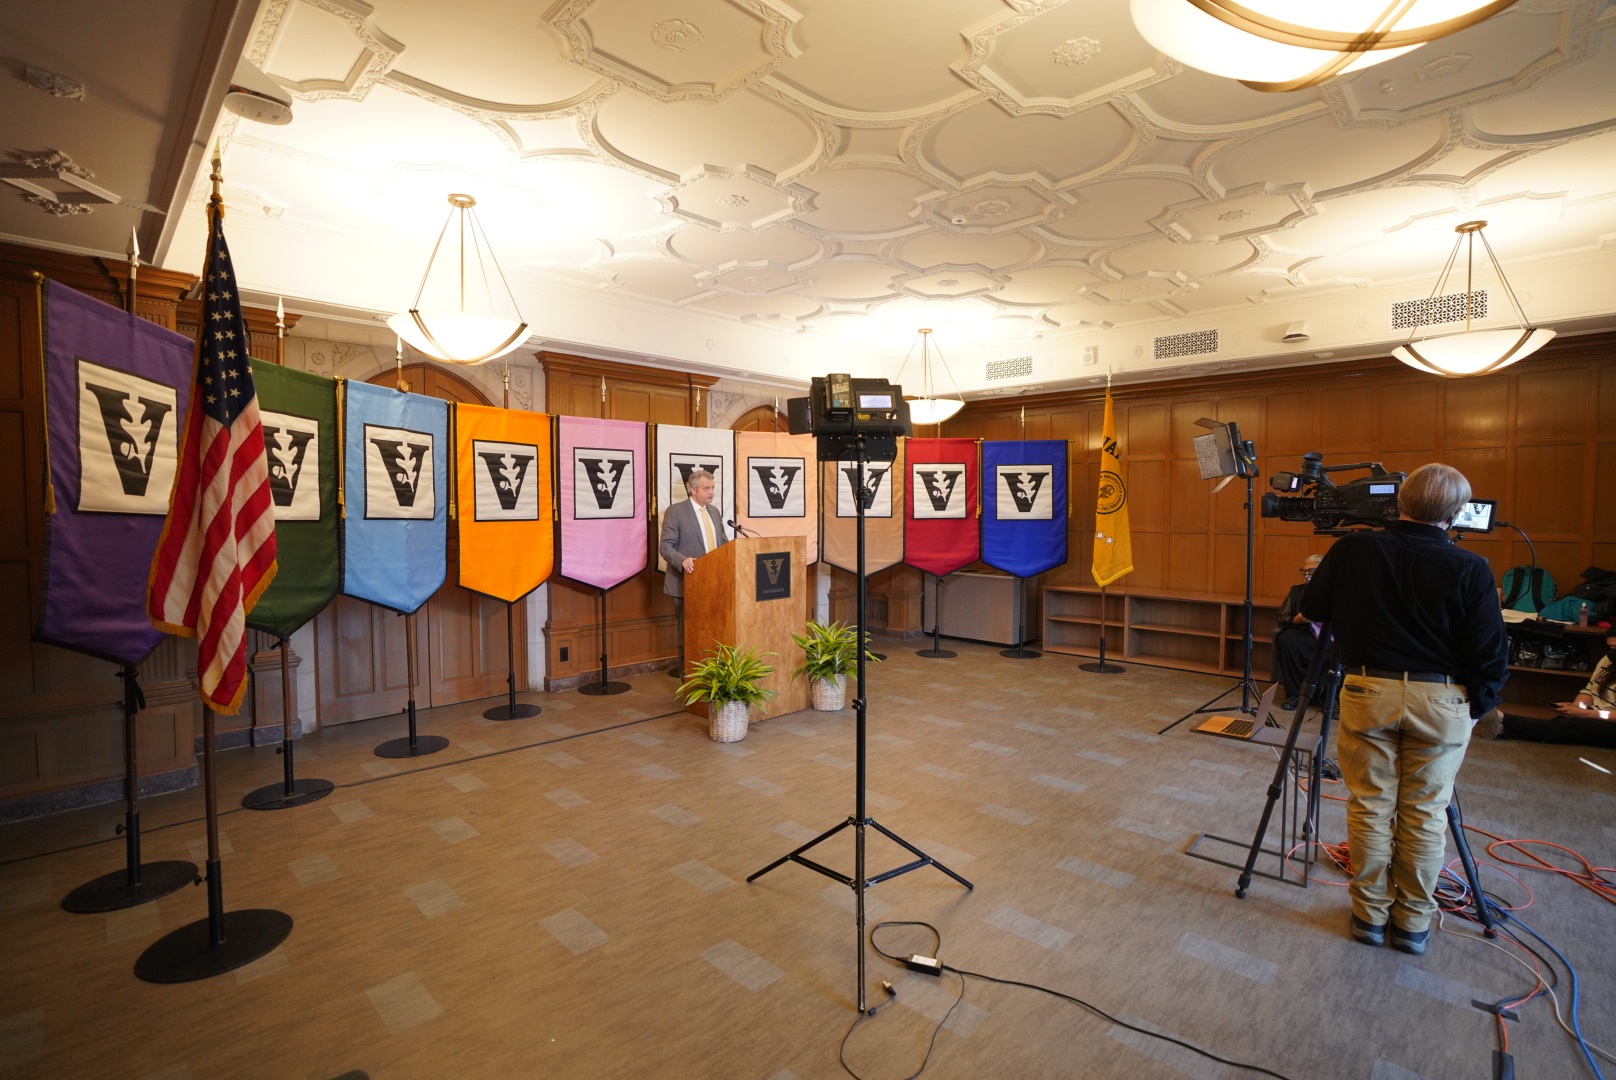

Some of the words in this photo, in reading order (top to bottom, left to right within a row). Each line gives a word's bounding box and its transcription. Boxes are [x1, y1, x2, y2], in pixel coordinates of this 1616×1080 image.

[85, 382, 172, 497] V
[262, 425, 315, 507] V
[370, 438, 430, 507] V
[478, 452, 535, 510] V
[578, 458, 631, 509] V
[752, 466, 801, 509] V
[916, 471, 963, 511] V
[1000, 473, 1049, 512] V
[762, 559, 785, 585] V
